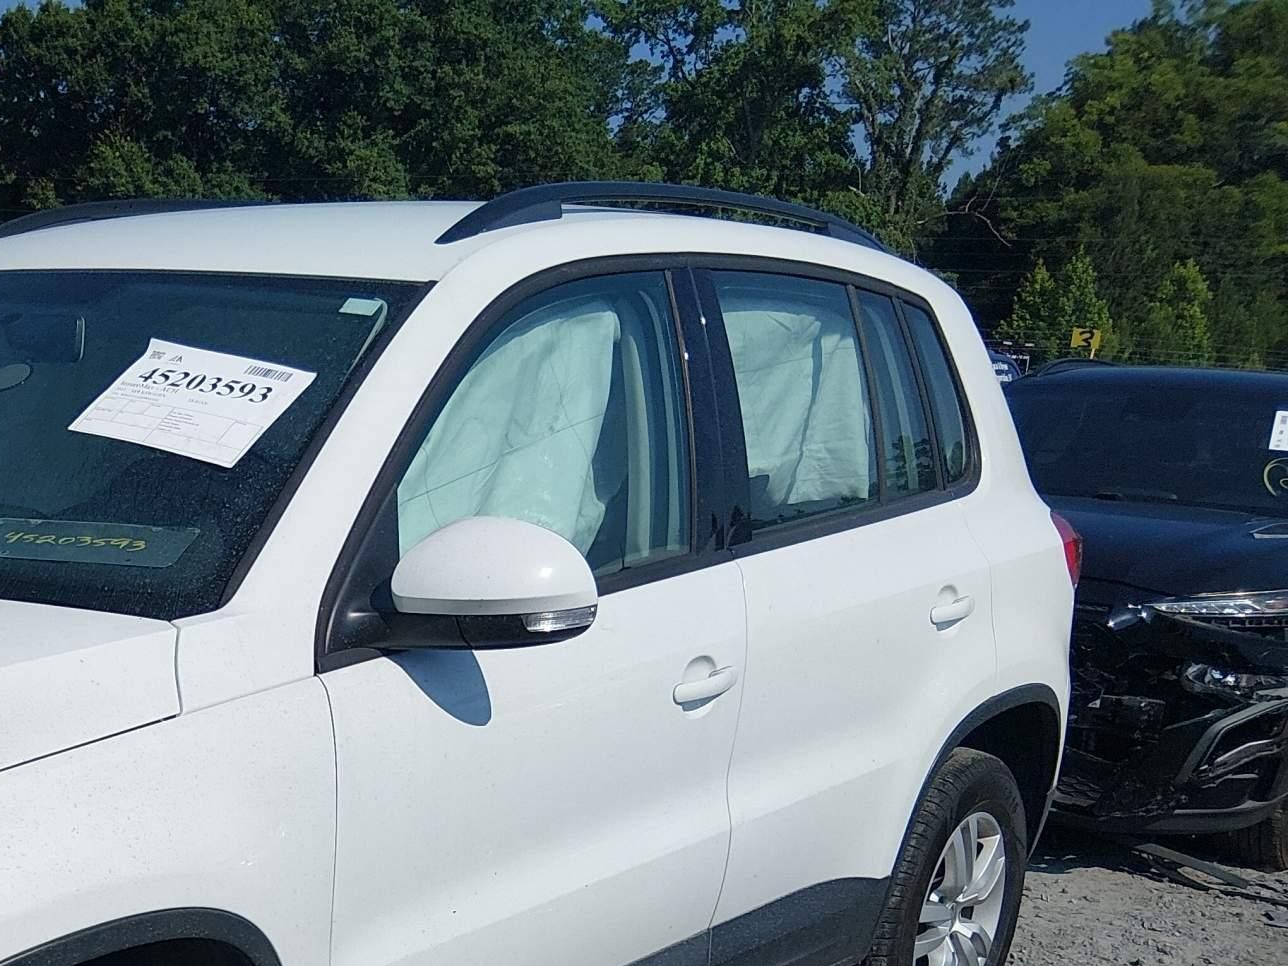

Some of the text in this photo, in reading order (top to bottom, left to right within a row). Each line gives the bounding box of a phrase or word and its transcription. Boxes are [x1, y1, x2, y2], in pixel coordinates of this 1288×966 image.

[1076, 329, 1095, 348] 3
[138, 367, 274, 404] 45203593
[4, 531, 147, 551] 45203593
